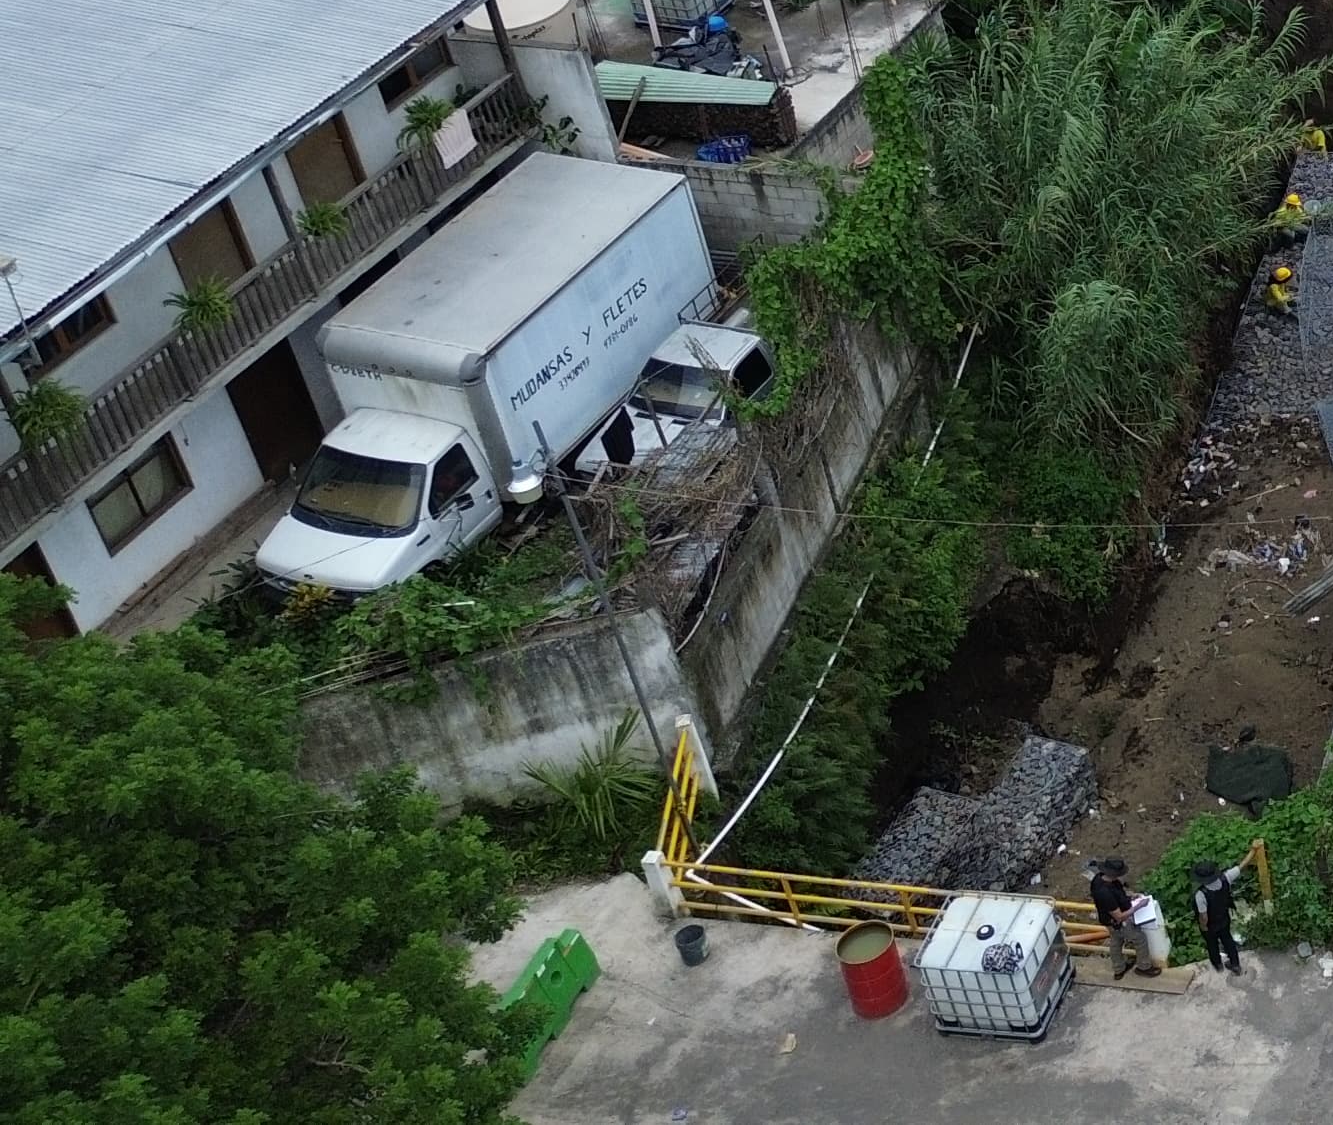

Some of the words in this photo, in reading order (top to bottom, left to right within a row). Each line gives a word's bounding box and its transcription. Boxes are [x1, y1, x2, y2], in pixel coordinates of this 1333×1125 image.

[510, 346, 573, 411] MUDANSAS
[581, 326, 591, 345] Y
[602, 277, 648, 328] FLETES
